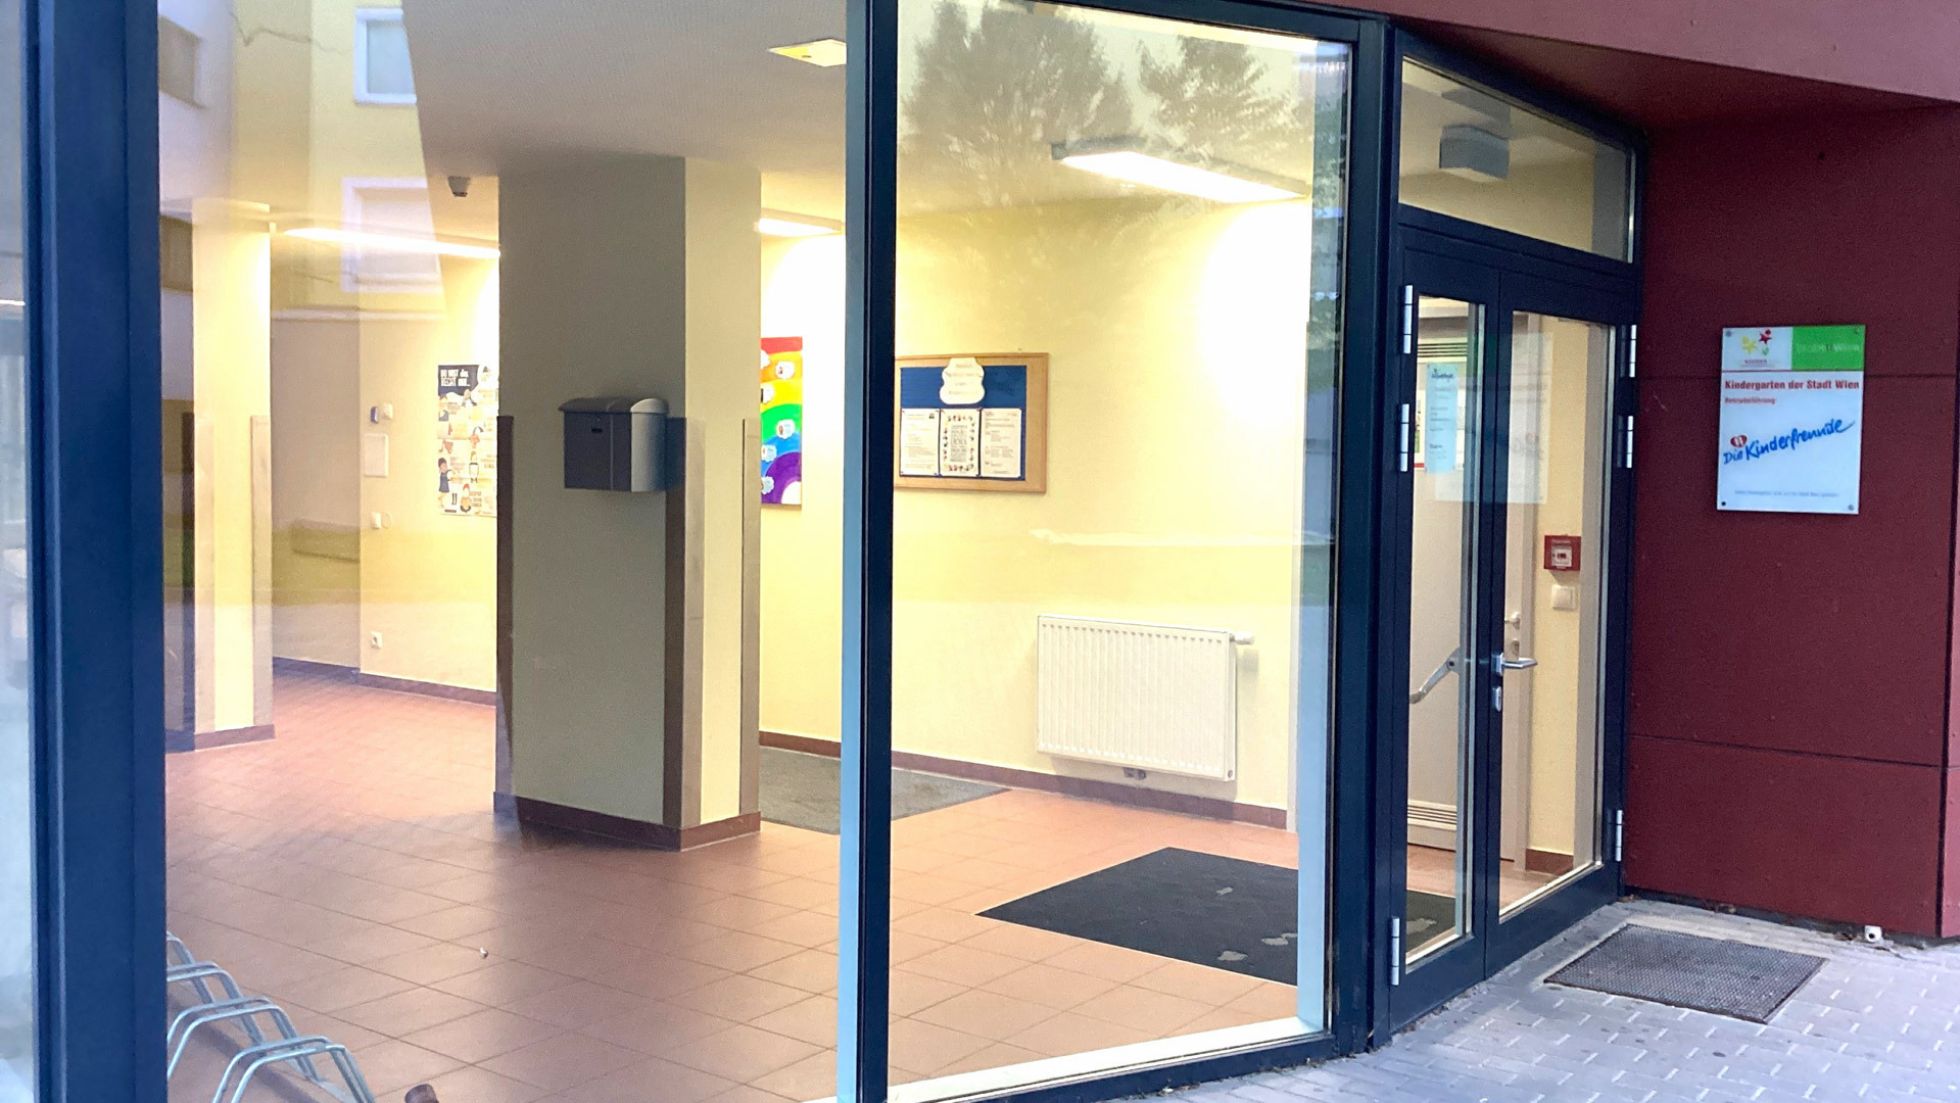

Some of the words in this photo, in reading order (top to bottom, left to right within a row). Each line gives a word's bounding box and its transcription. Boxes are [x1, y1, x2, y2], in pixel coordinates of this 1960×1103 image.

[1725, 380, 1785, 391] Kindergarten
[1788, 380, 1804, 389] der
[1806, 380, 1832, 389] Stadt
[1835, 379, 1860, 389] Wien
[1723, 450, 1743, 464] Die
[1745, 418, 1855, 460] Kinderfreunde
